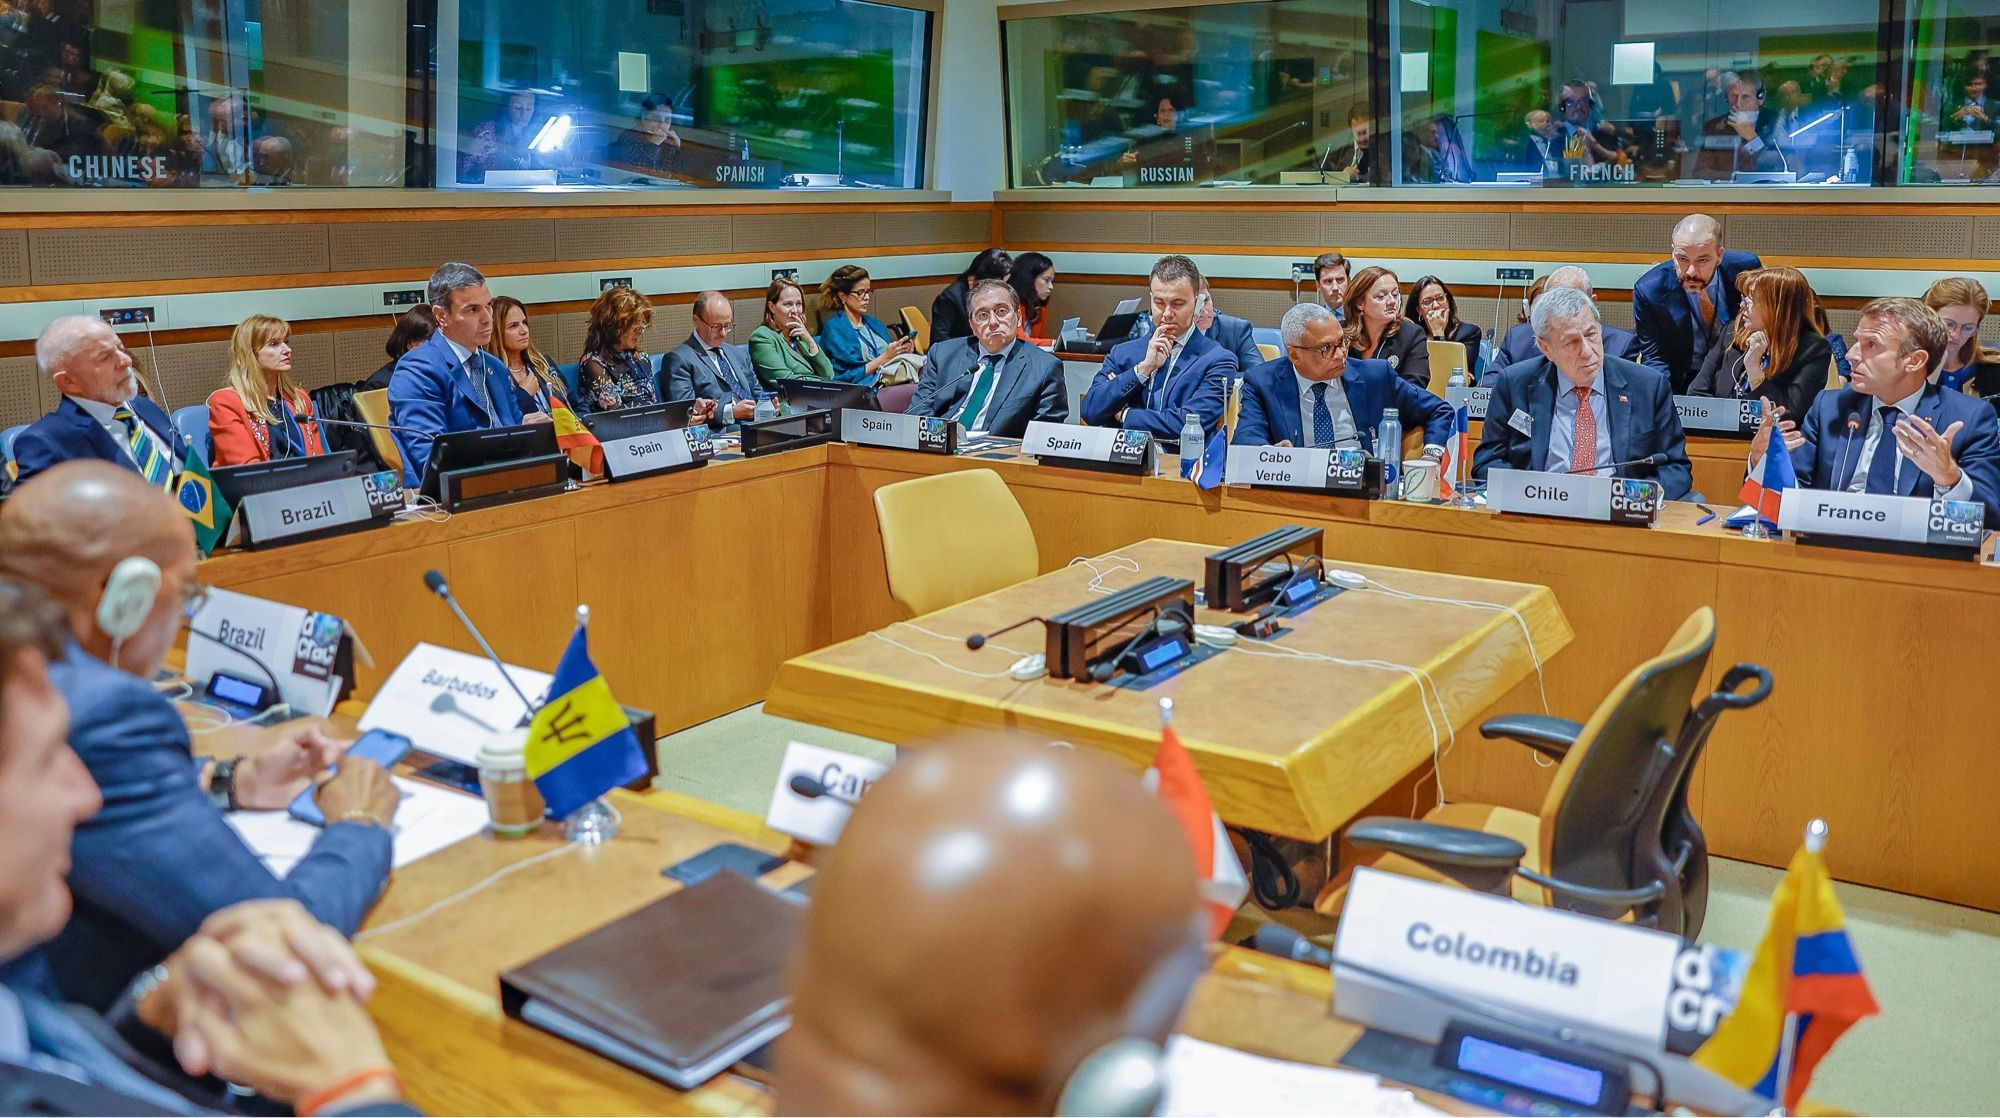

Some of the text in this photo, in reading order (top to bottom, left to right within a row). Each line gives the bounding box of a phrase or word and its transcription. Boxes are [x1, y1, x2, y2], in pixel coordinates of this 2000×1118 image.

[69, 155, 167, 179] CHINESE
[716, 166, 765, 182] SPANISH
[1140, 167, 1194, 182] RUSSIAN
[1570, 164, 1635, 181] FRENCH
[1472, 391, 1491, 400] Cab
[1470, 405, 1487, 414] Ver
[1675, 406, 1708, 417] Chile
[862, 418, 892, 431] Spain
[1740, 413, 1762, 424] cra
[920, 431, 946, 443] crac
[1046, 437, 1082, 451] Spain
[629, 442, 663, 457] Spain
[689, 439, 712, 451] crac
[1113, 443, 1144, 454] crac
[1259, 451, 1292, 464] Cabo
[1256, 470, 1291, 481] Verde
[1328, 465, 1363, 478] crac
[368, 487, 403, 505] crac
[1524, 485, 1569, 502] Chile
[1612, 496, 1655, 512] crac
[281, 500, 335, 526] Brazil
[1817, 503, 1886, 522] France
[1929, 516, 1981, 534] crac
[218, 619, 266, 650] Brazil
[297, 637, 338, 667] crac
[421, 668, 498, 700] Barbados
[1406, 922, 1579, 987] Colombia
